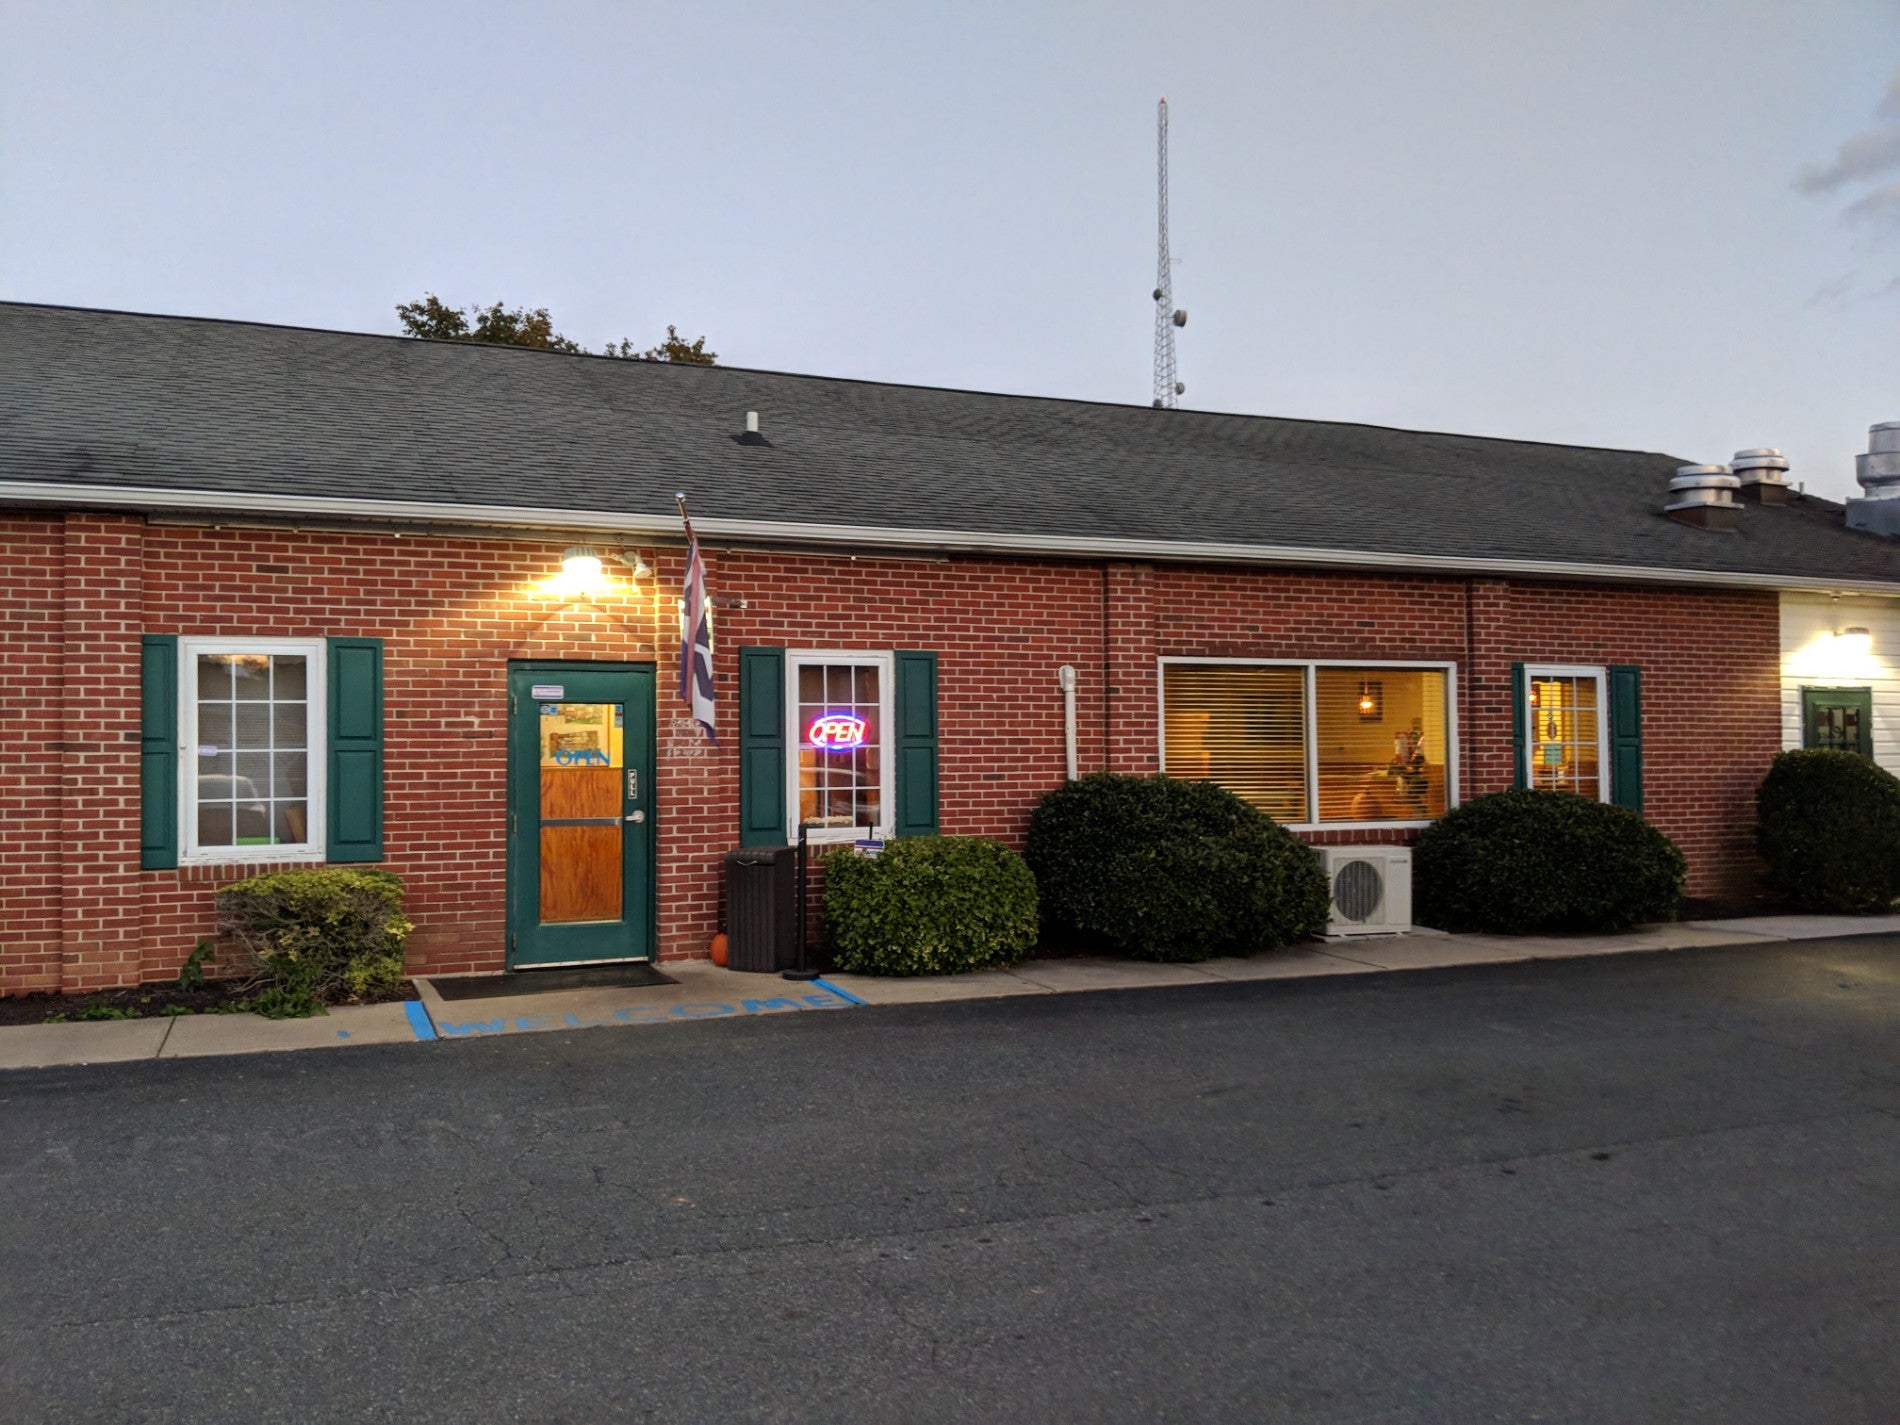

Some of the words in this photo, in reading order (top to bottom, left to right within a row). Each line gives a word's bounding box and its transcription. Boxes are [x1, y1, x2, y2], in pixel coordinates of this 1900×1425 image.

[809, 721, 866, 746] OPEN
[555, 749, 611, 766] OPEN
[439, 994, 846, 1035] WELCOME
